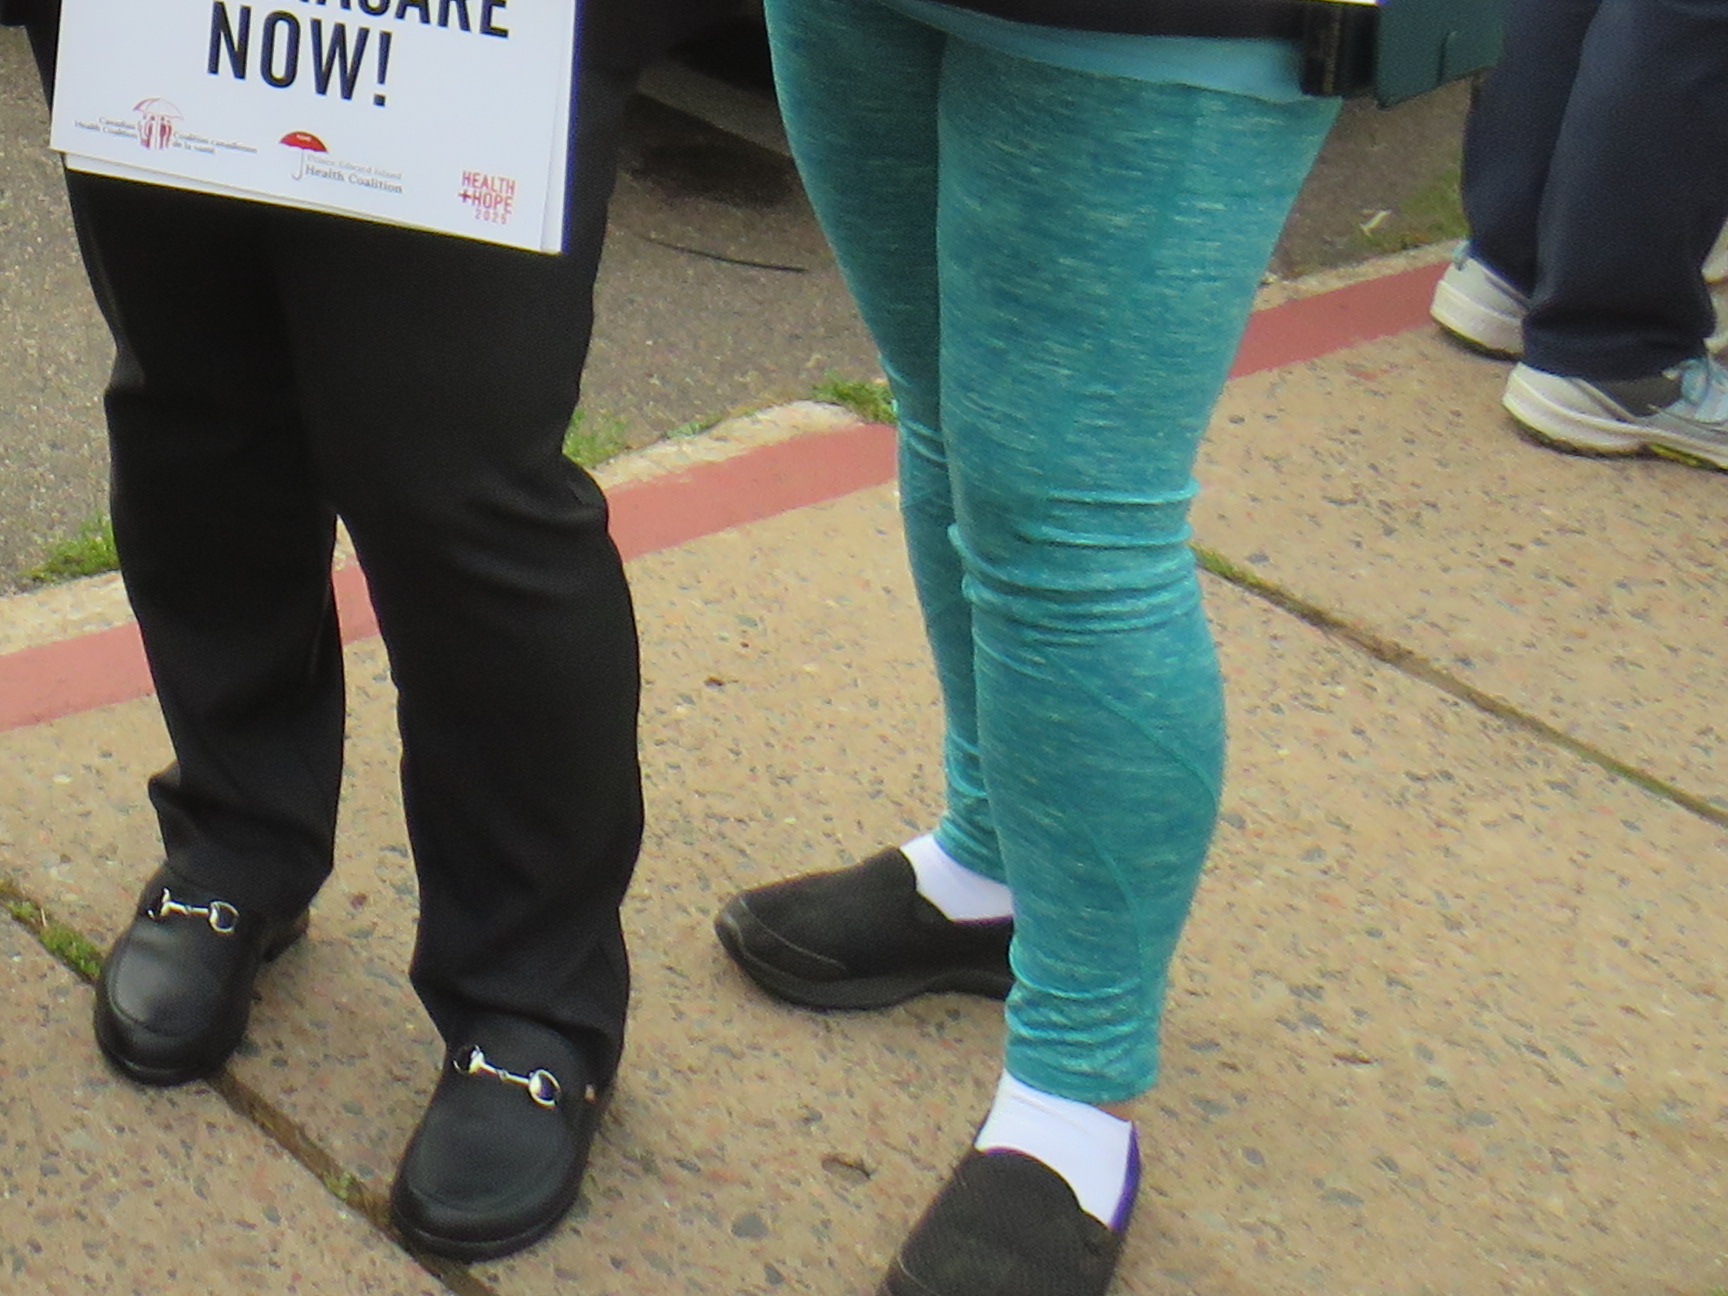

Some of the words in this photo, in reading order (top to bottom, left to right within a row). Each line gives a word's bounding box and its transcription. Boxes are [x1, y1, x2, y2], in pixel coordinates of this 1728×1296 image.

[207, 0, 393, 108] NOW!
[305, 163, 345, 182] Health
[348, 174, 403, 194] Coalition
[462, 170, 516, 195] HEALTH
